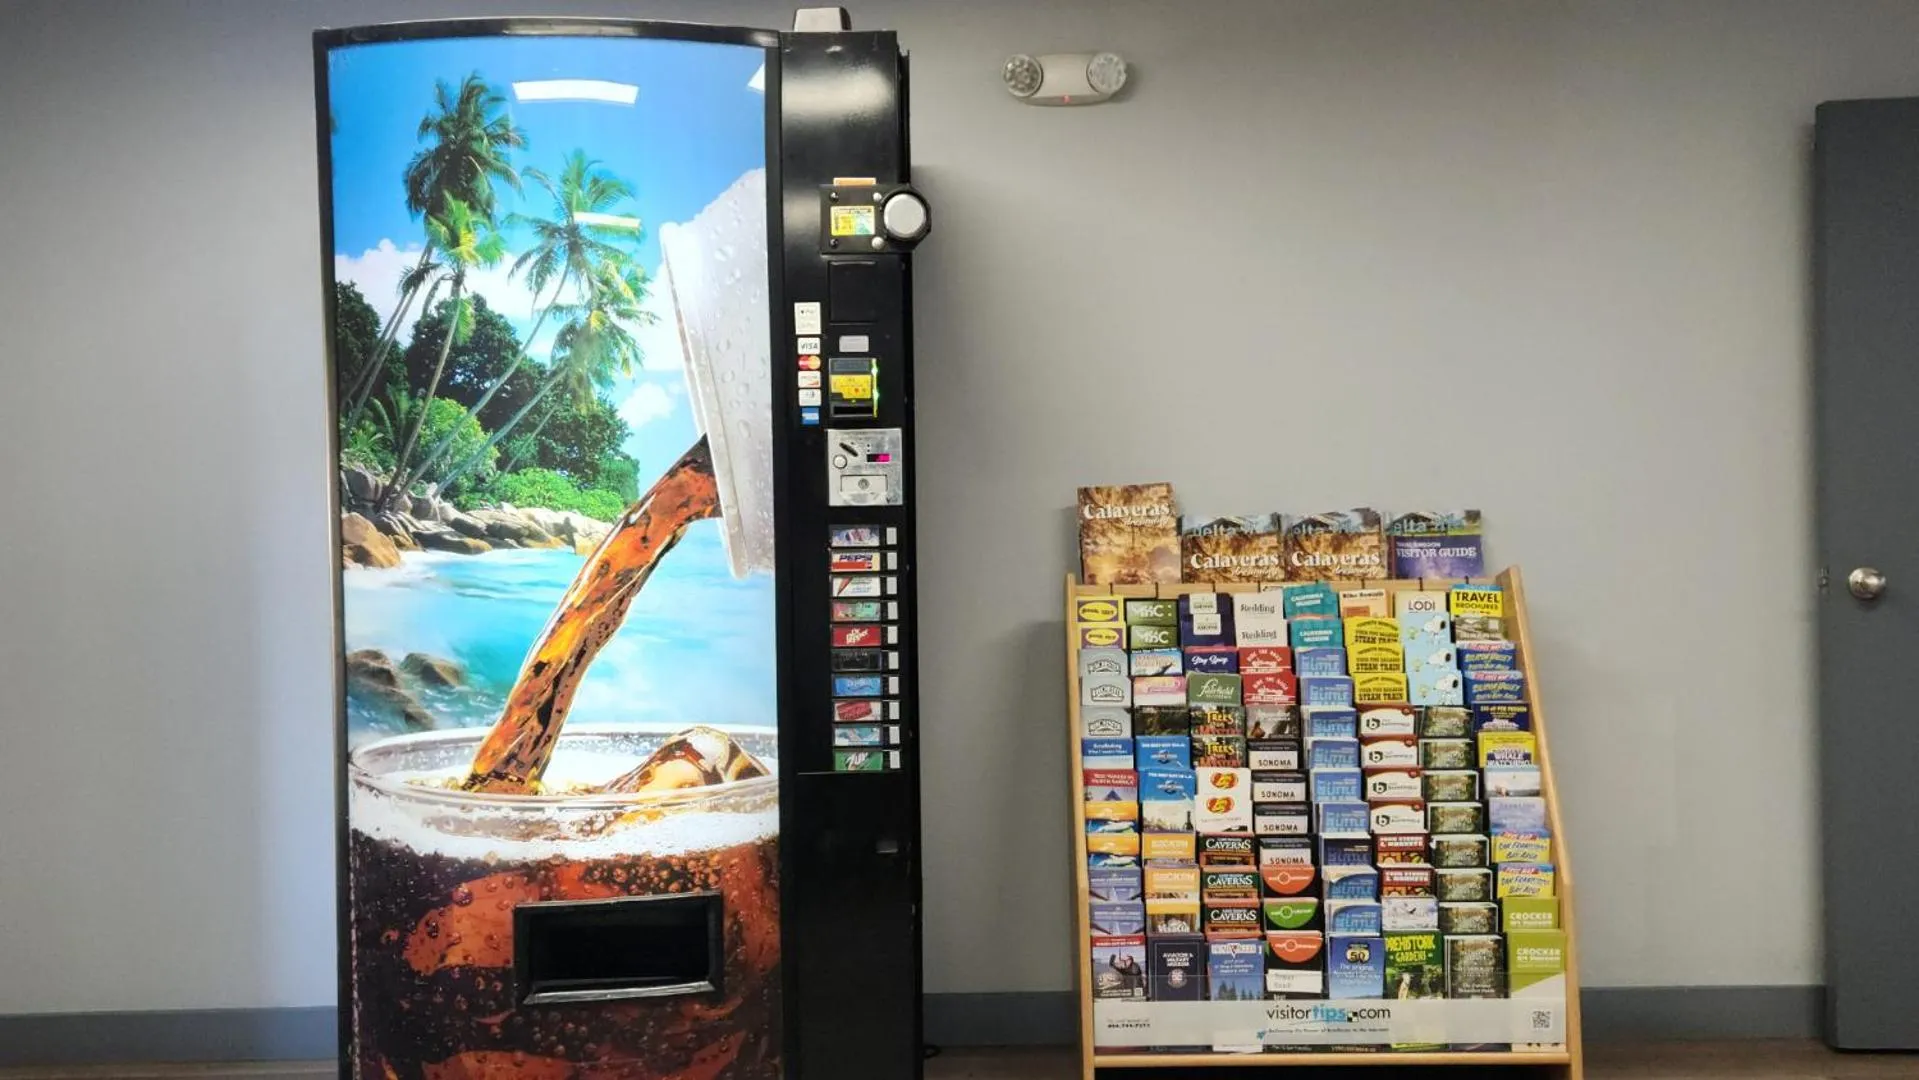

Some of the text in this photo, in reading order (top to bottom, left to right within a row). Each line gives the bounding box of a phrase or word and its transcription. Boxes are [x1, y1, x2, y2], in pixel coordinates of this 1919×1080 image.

[1083, 503, 1170, 519] Calaveras
[1397, 547, 1477, 558] VISITOR GUIDE
[1190, 552, 1279, 569] Calaveras
[1291, 551, 1381, 567] Calaveras
[1455, 591, 1500, 603] TRAVEL
[1241, 604, 1275, 613] Redding
[1408, 600, 1436, 611] LODI
[1207, 710, 1234, 723] TREES
[1206, 742, 1235, 756] TREES
[1206, 838, 1252, 849] CAVERNS
[1270, 856, 1304, 865] SONOMA
[1207, 874, 1253, 885] CAVERNS
[1210, 909, 1257, 920] CAVERNS
[1509, 912, 1553, 920] CROCKER
[1384, 935, 1436, 951] PREHISTORIC
[1350, 951, 1366, 961] 50
[1517, 947, 1562, 956] CROCKER
